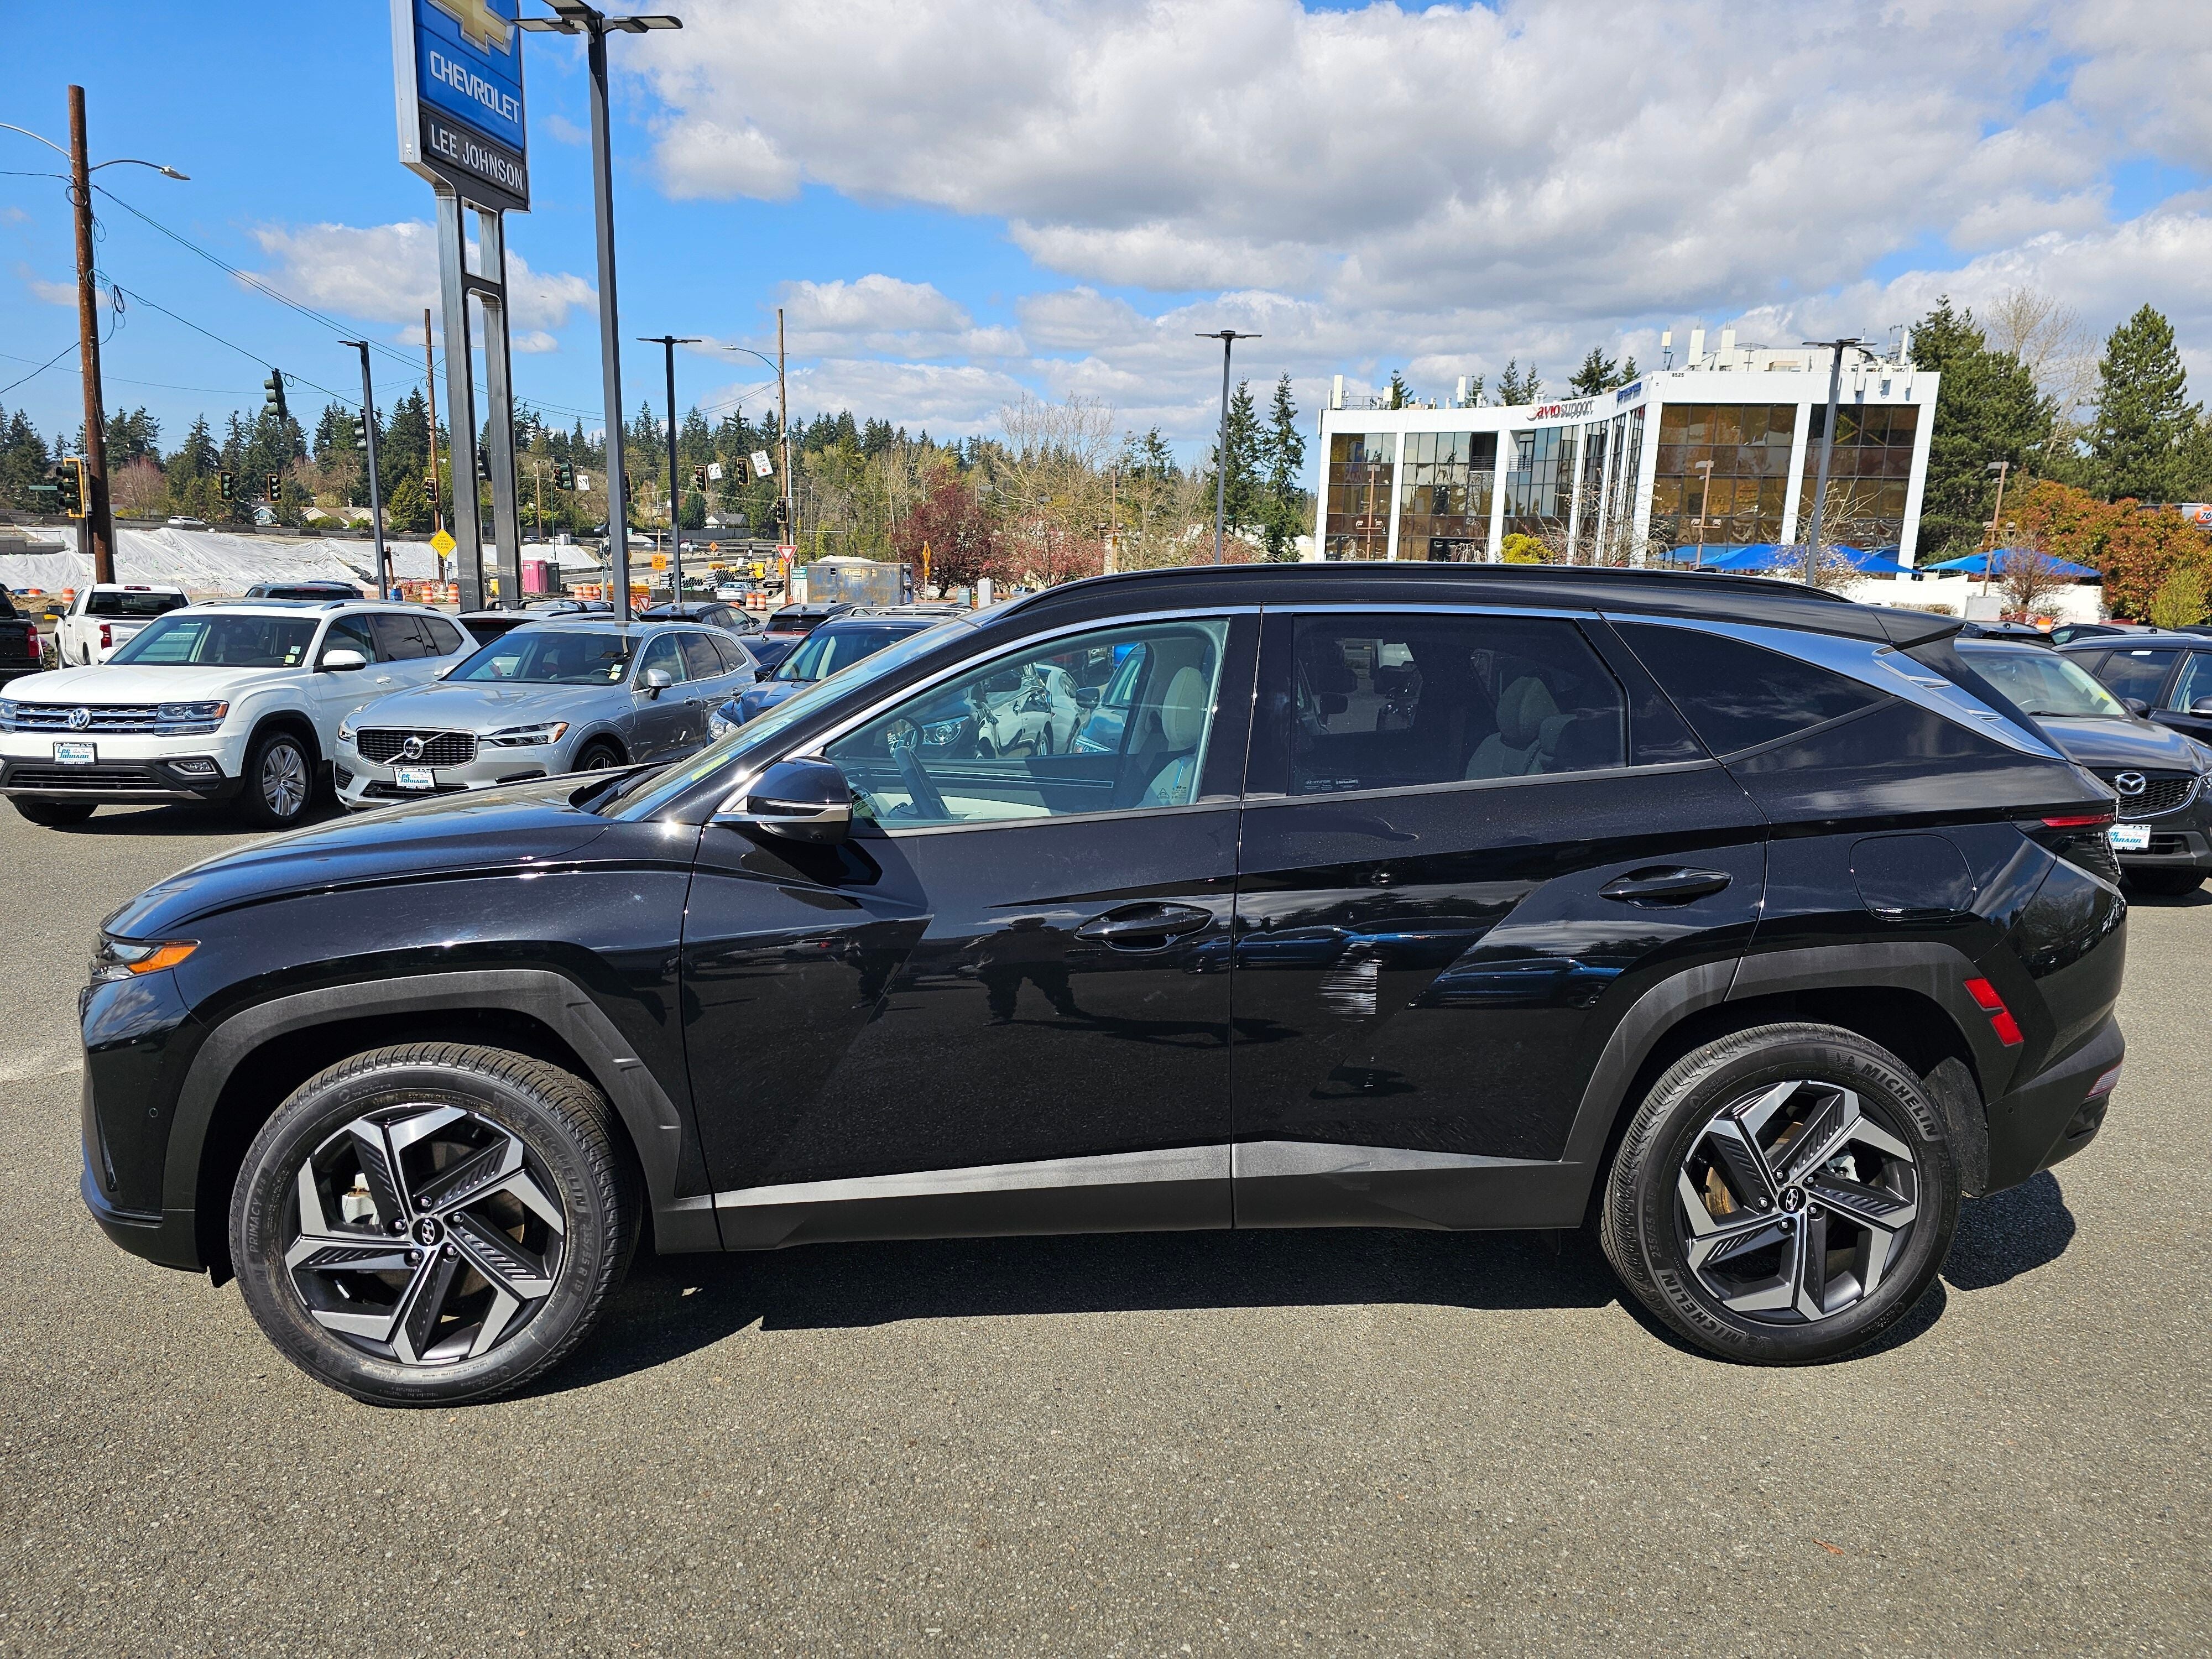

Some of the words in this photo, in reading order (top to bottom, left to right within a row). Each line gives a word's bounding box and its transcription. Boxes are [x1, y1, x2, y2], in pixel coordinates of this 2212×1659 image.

[430, 50, 519, 124] CHEVROLET
[431, 124, 458, 159] LEE
[462, 142, 523, 191] JOHNSON
[399, 775, 429, 784] Johnson
[2111, 835, 2142, 843] hnson
[1860, 1063, 1938, 1136] MICHELIN
[529, 1124, 588, 1207] MICHELIN
[249, 1197, 262, 1253] PRIMACY
[1646, 1205, 1655, 1214] R
[581, 1223, 592, 1265] 235/55
[1646, 1219, 1662, 1258] 235/55
[575, 1280, 585, 1291] 19
[577, 1266, 588, 1276] R
[1660, 1274, 1742, 1344] MICHELIN
